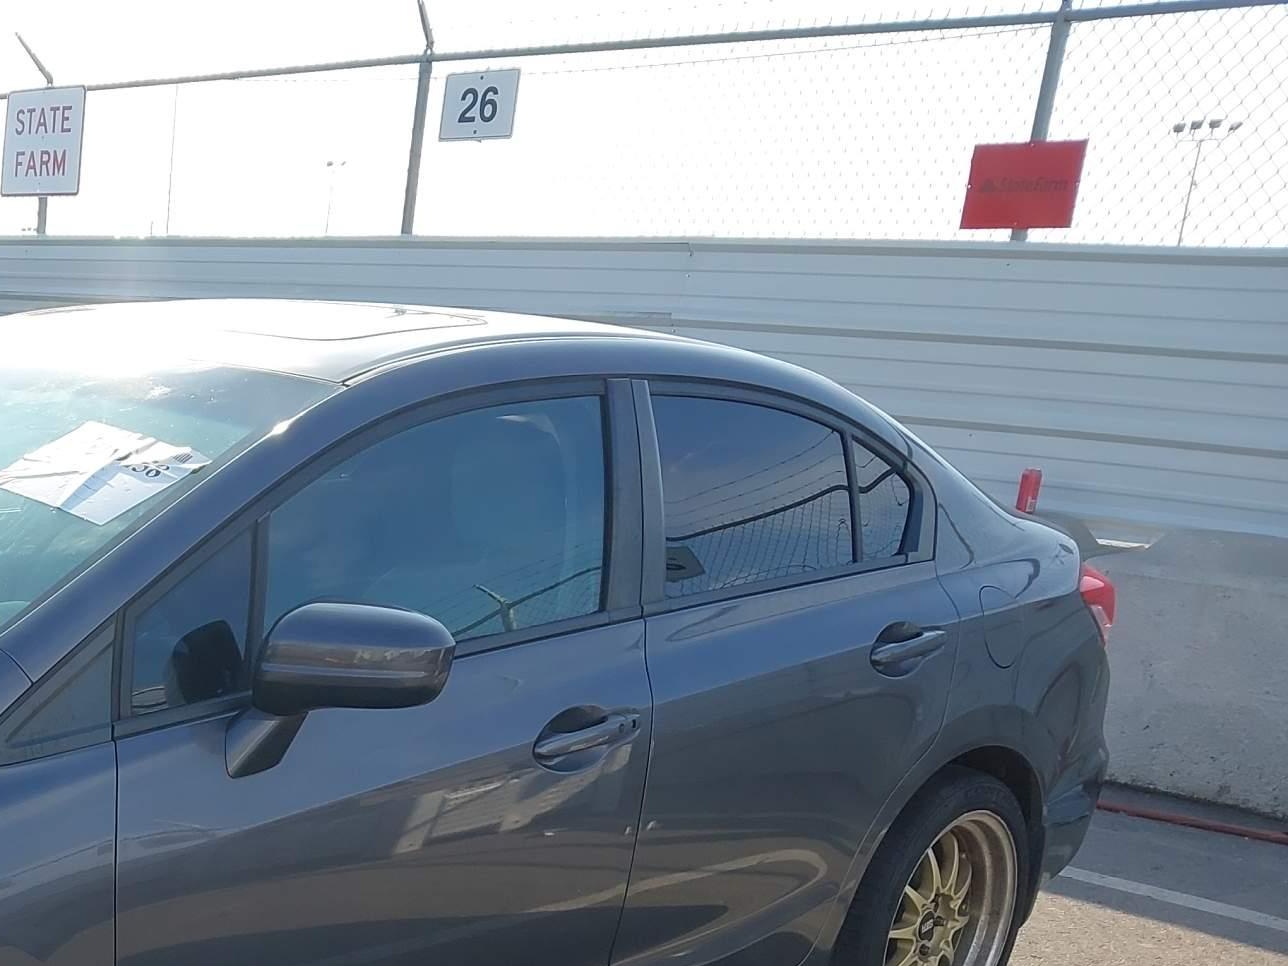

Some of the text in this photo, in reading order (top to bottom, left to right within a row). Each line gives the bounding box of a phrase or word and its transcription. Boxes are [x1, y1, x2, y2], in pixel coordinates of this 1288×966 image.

[458, 86, 499, 123] 26
[15, 105, 73, 136] STATE
[14, 148, 67, 177] FARM
